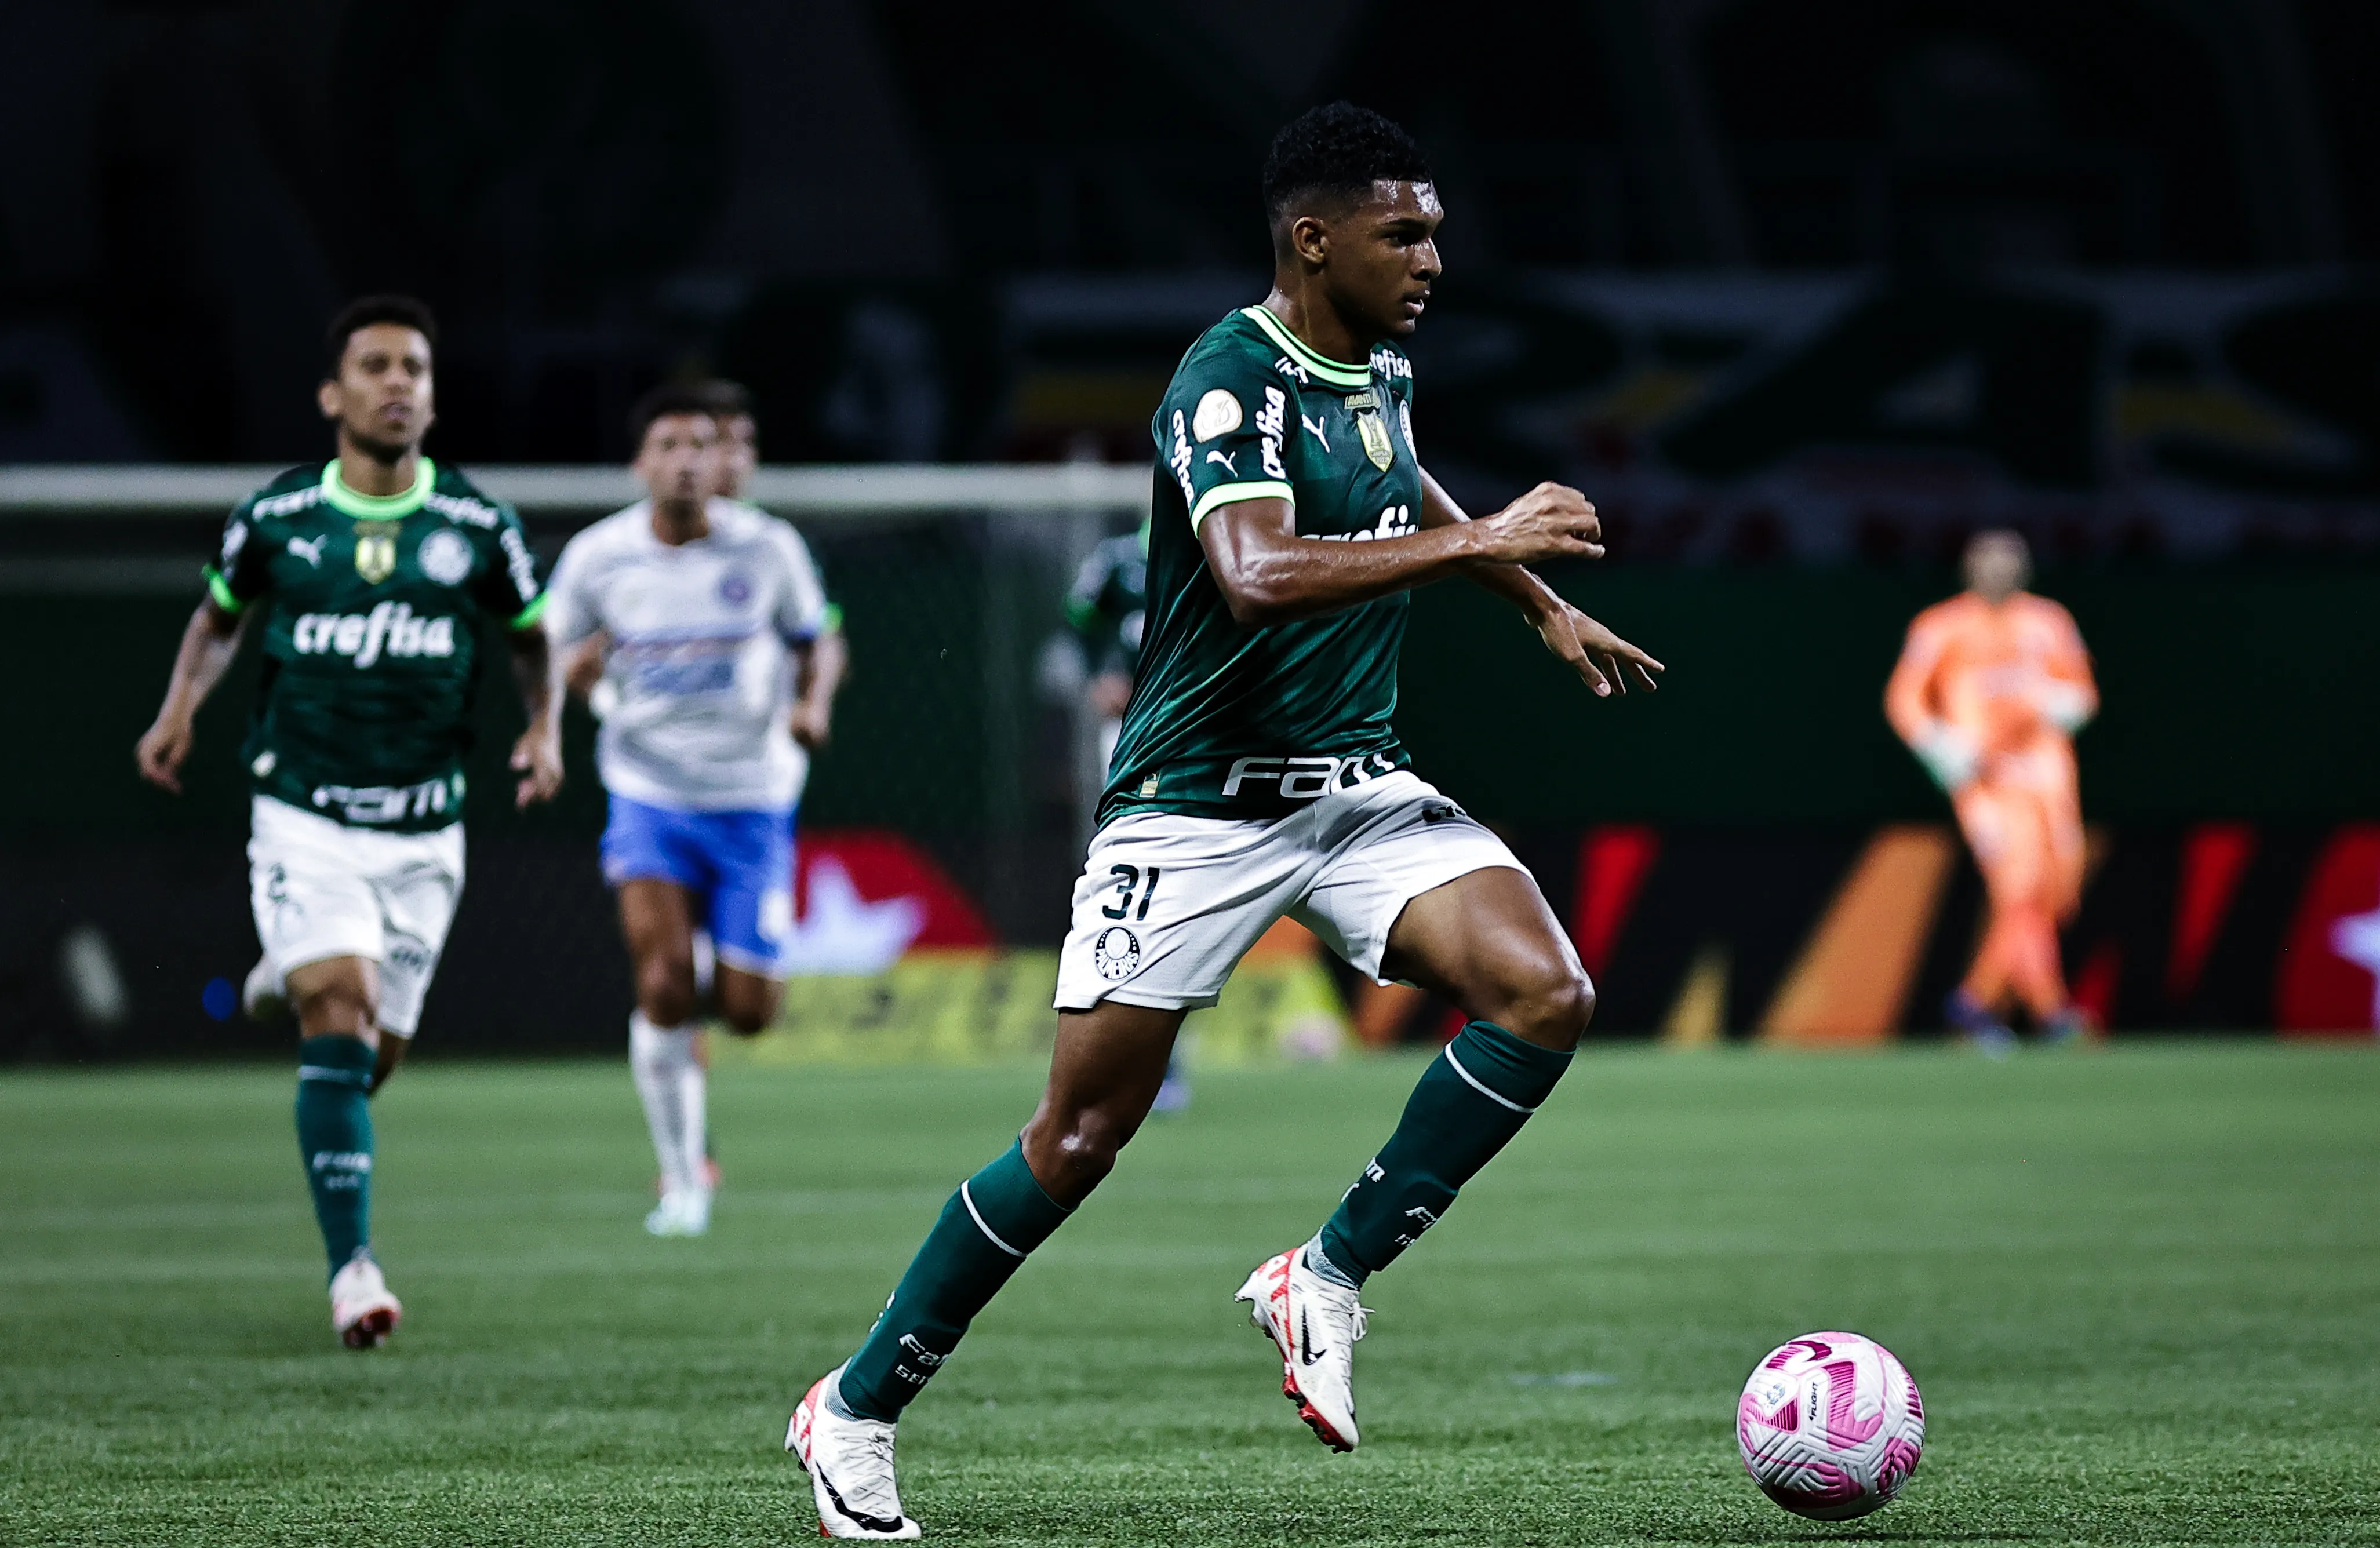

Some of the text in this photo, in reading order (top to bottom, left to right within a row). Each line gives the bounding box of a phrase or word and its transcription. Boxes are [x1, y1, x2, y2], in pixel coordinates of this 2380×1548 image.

[1369, 348, 1413, 381] refisa
[293, 600, 455, 669] crefisa
[1102, 864, 1160, 921] 31
[1096, 948, 1139, 979] PALMEIRAS
